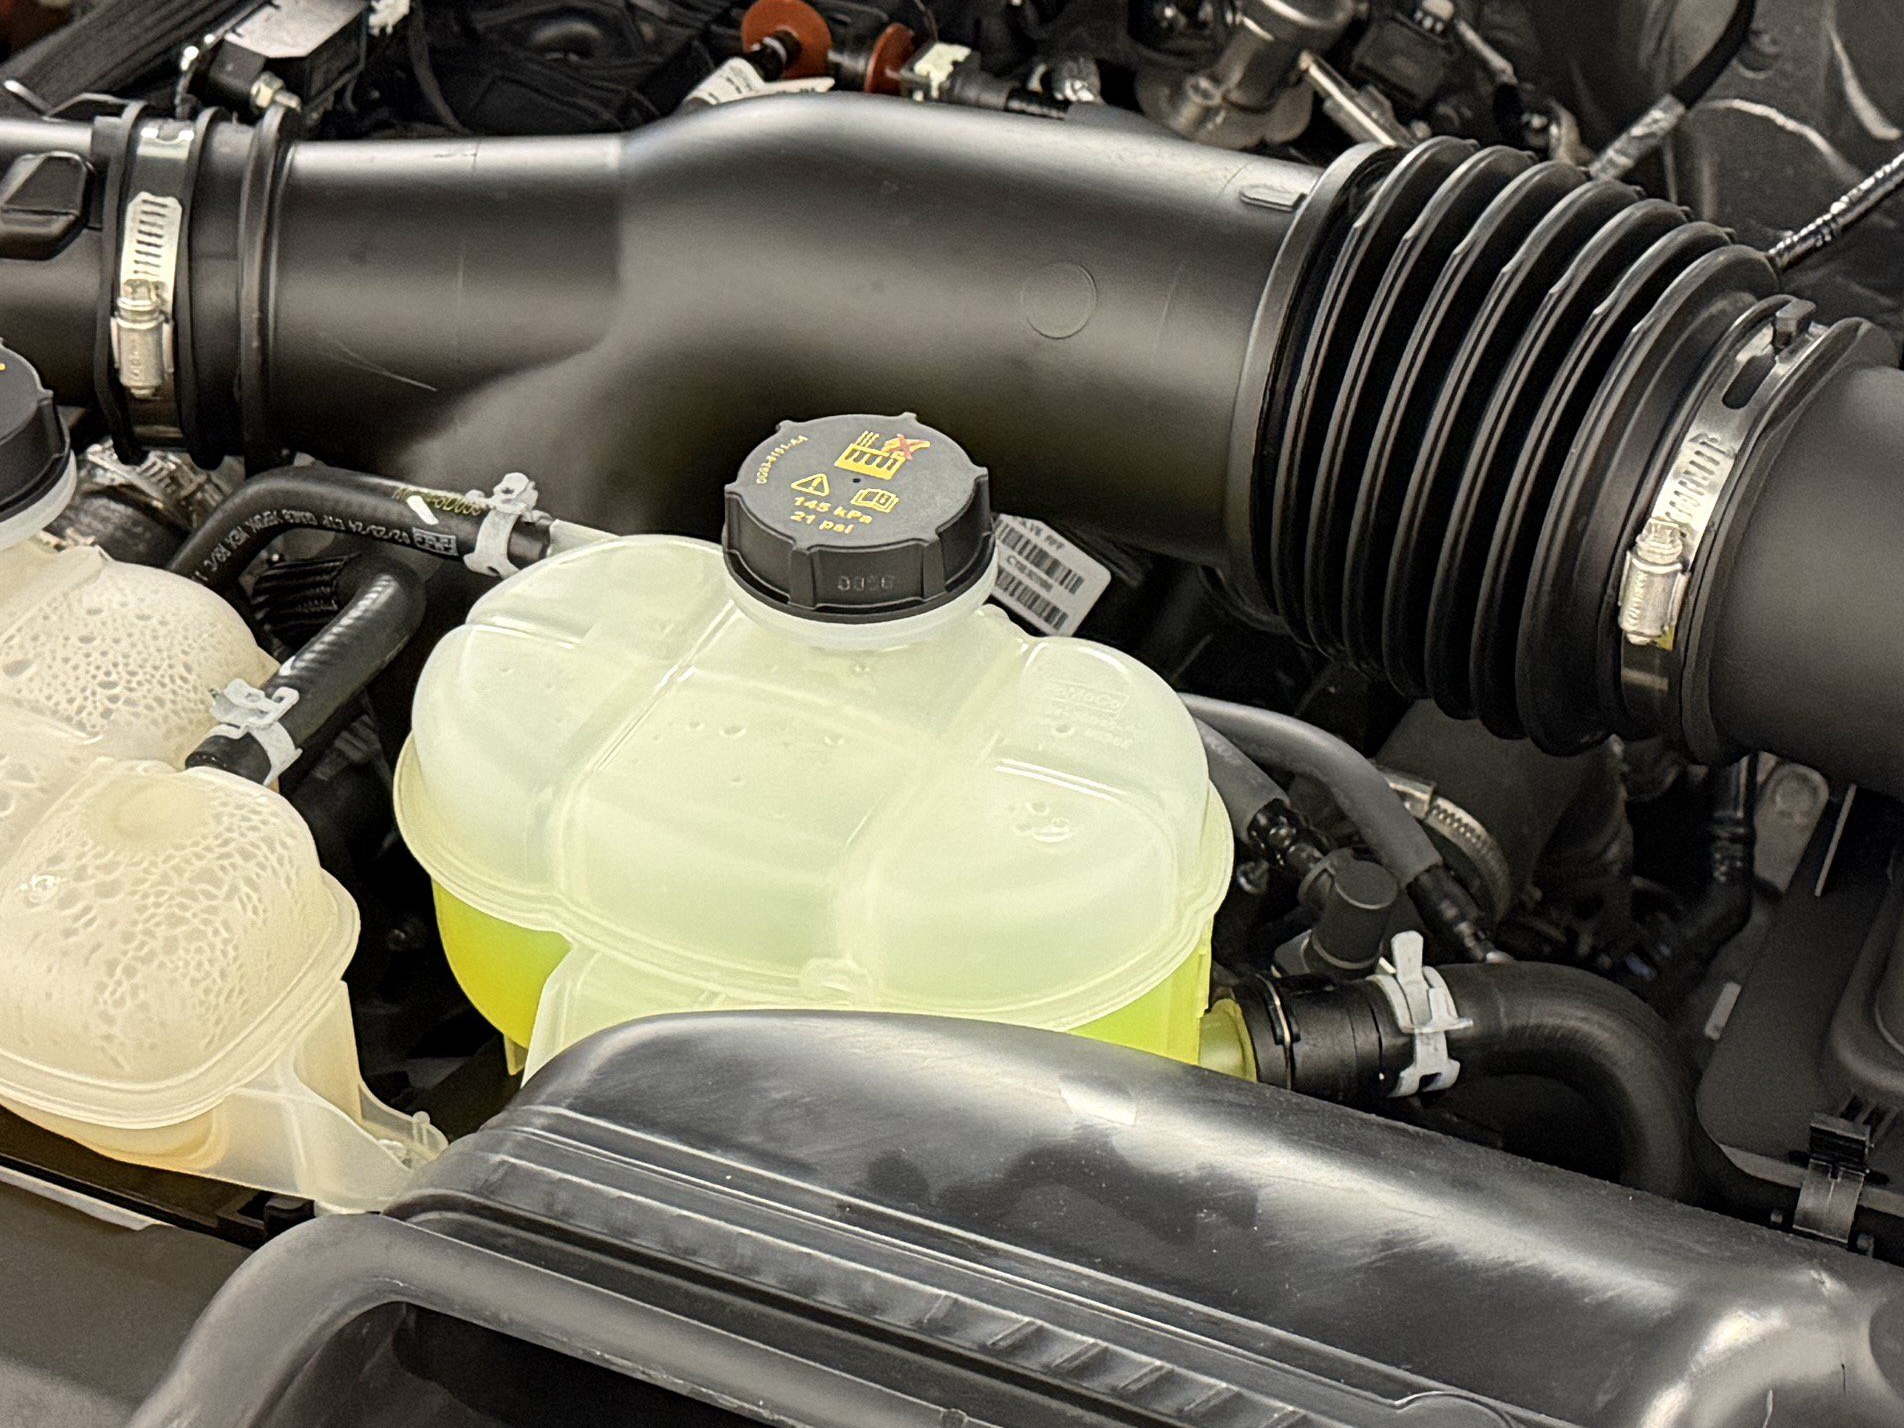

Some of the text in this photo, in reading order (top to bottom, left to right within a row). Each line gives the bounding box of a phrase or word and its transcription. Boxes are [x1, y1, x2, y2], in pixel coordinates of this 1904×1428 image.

[790, 510, 856, 534] 21 psi
[794, 495, 873, 524] 145 kPa
